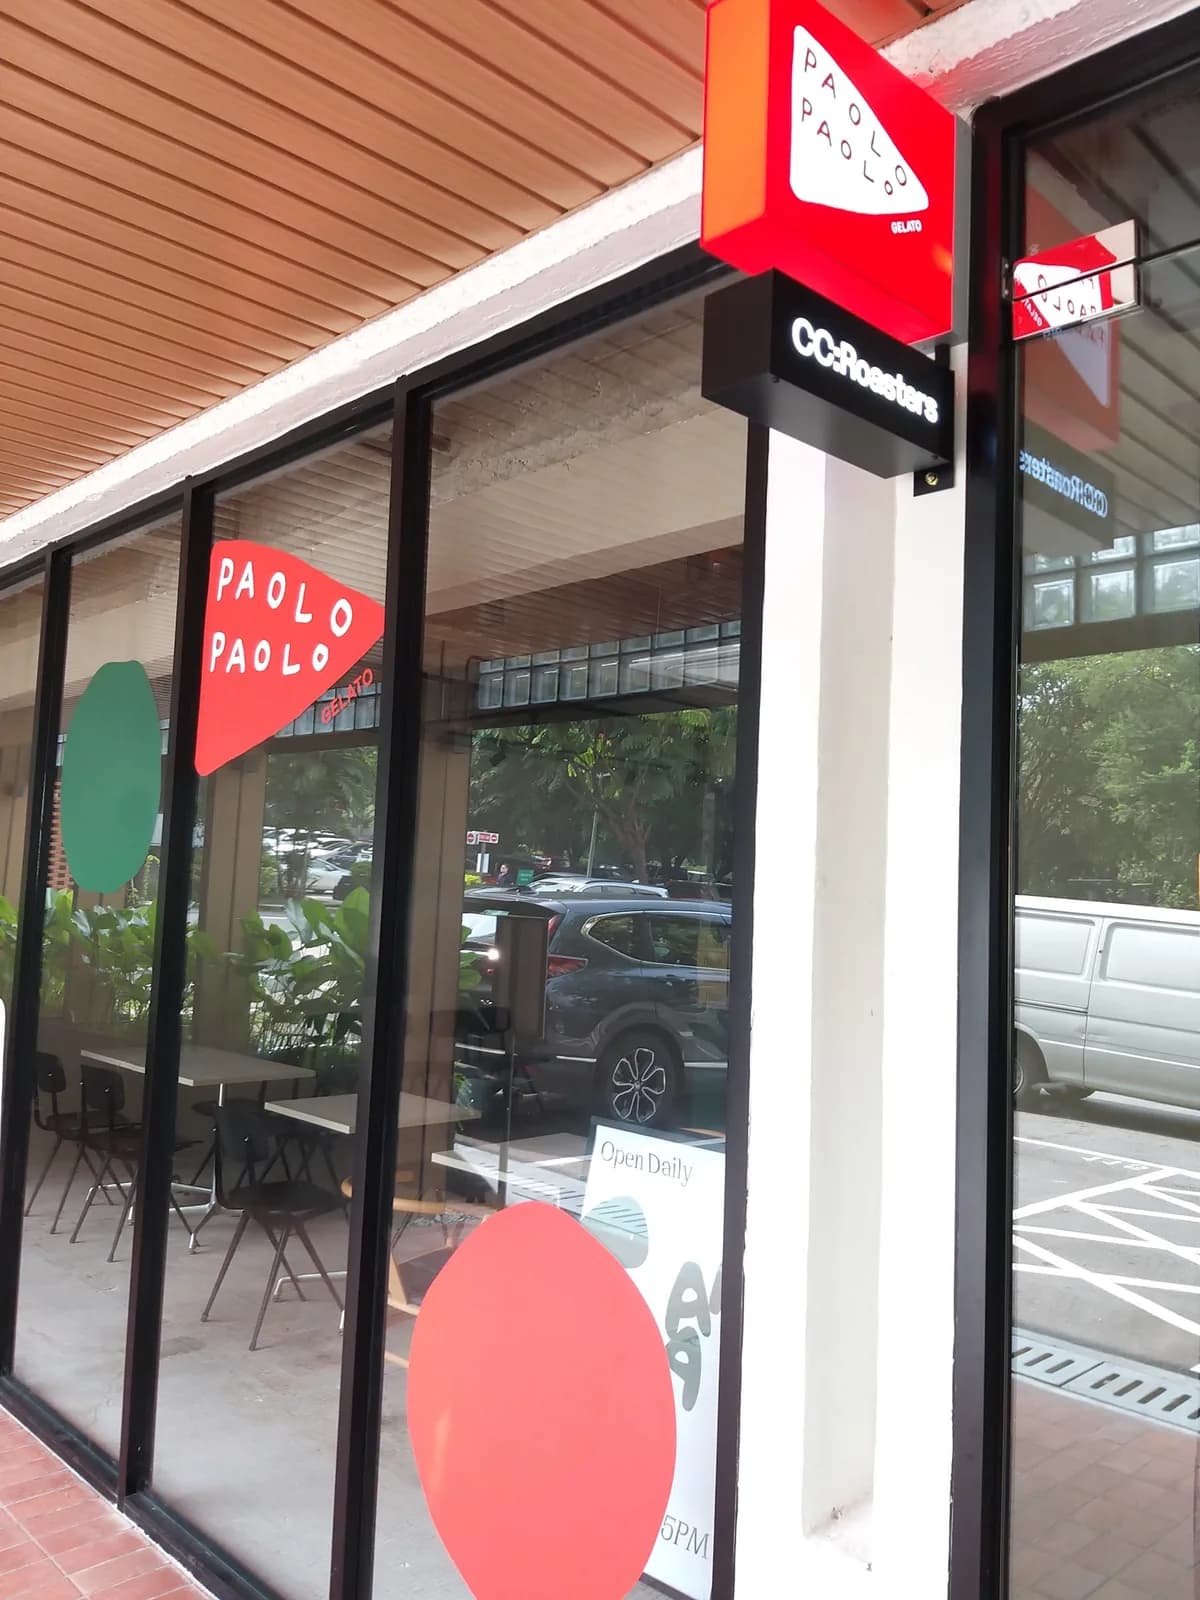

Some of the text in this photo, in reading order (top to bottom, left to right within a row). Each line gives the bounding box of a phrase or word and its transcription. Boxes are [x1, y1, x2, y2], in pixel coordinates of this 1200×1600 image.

[804, 48, 907, 187] PAOLO
[801, 97, 893, 196] PAOLO
[890, 219, 923, 235] GELATO
[791, 316, 939, 424] CC:Roasters
[216, 557, 354, 638] PAOLO
[209, 631, 330, 676] PAOLO
[320, 668, 374, 725] GELATO
[600, 1140, 694, 1188] Open Daily
[660, 1514, 711, 1560] 5PM
